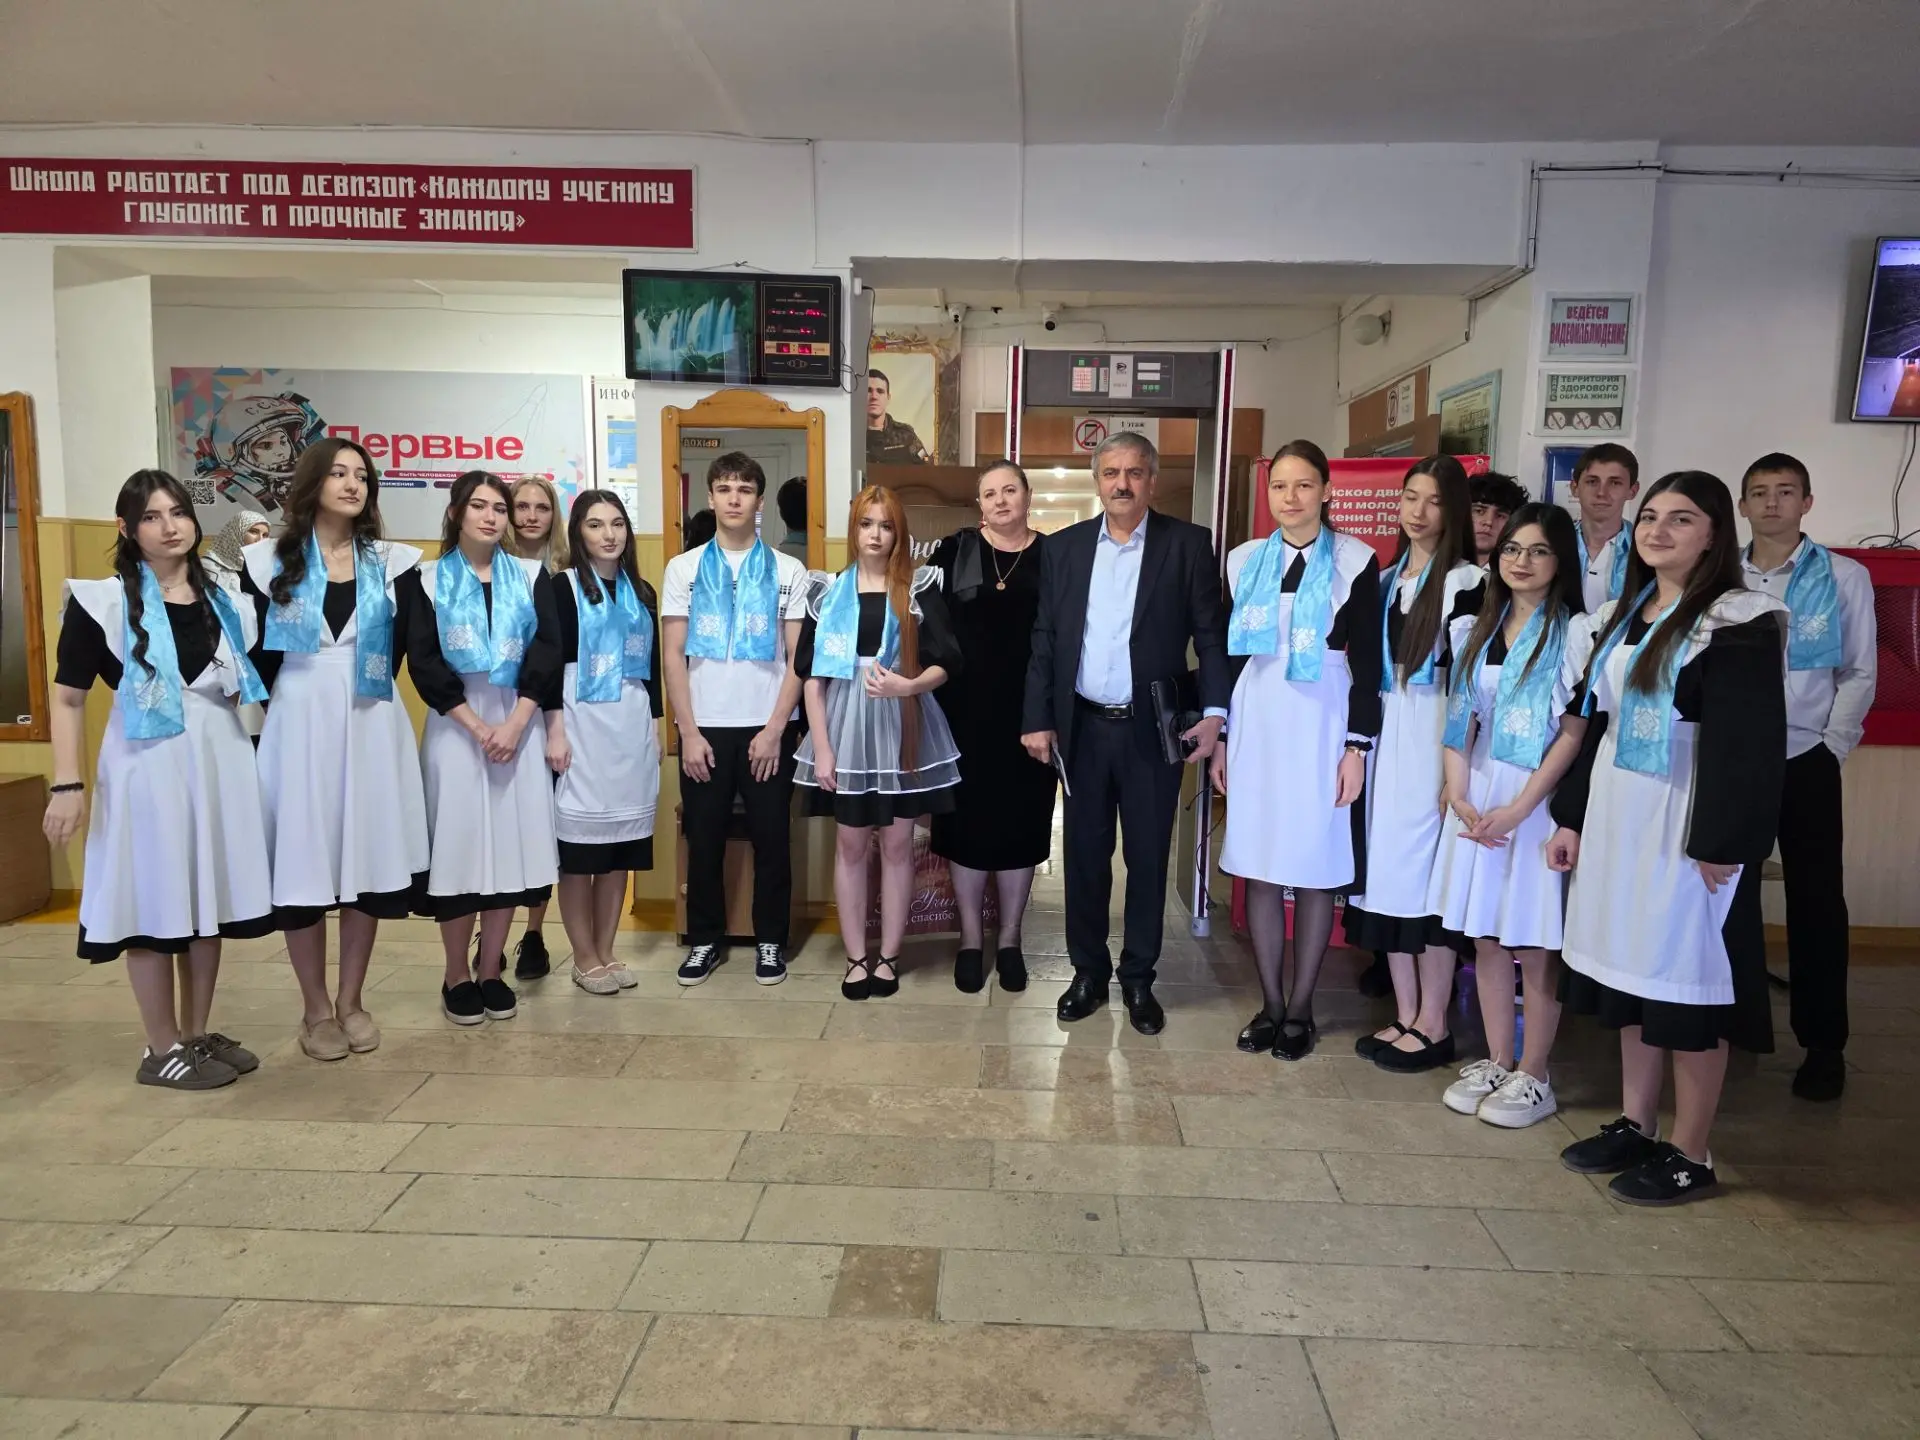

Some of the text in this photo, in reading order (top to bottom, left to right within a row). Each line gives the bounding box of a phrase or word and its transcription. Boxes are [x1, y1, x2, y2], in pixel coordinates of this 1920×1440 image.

[108, 171, 230, 194] РАБОТАЕТ
[243, 173, 290, 196] ПОД
[562, 180, 674, 204] УЧЕНИКУ
[124, 201, 526, 232] ГЛУБОКИЕ И ПРОЧНЫЕ ЗНАНИЯ»
[1566, 304, 1609, 321] ВЕДЁТСЯ
[1560, 384, 1619, 392] ЗДОРОВОГО
[328, 425, 524, 468] Первые
[911, 911, 955, 924] спасибо
